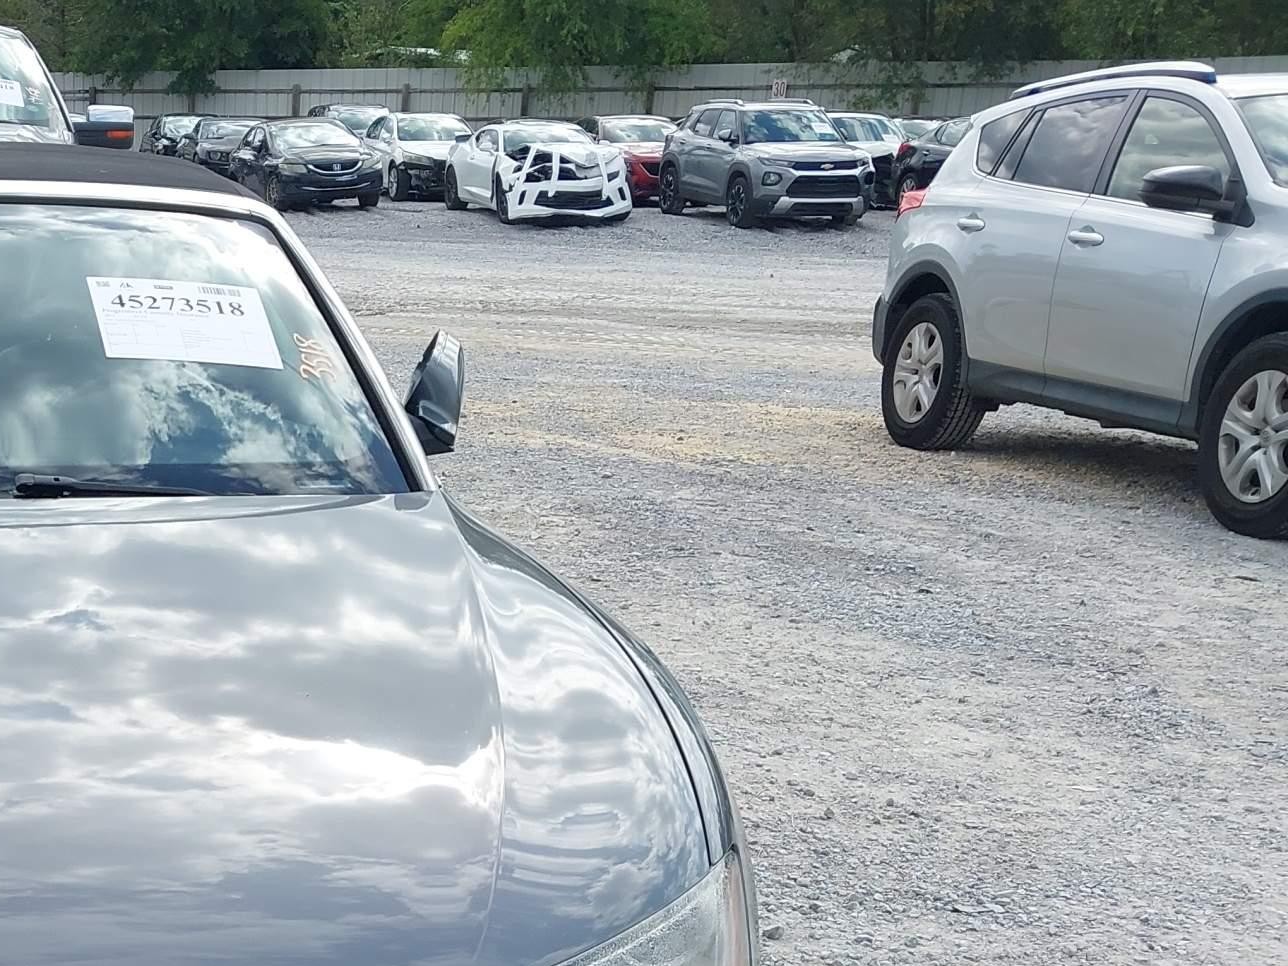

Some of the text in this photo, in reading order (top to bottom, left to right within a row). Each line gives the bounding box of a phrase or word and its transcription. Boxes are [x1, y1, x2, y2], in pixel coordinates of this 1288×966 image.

[773, 81, 786, 97] 30
[111, 293, 245, 317] 45273518
[293, 333, 336, 382] 3518
